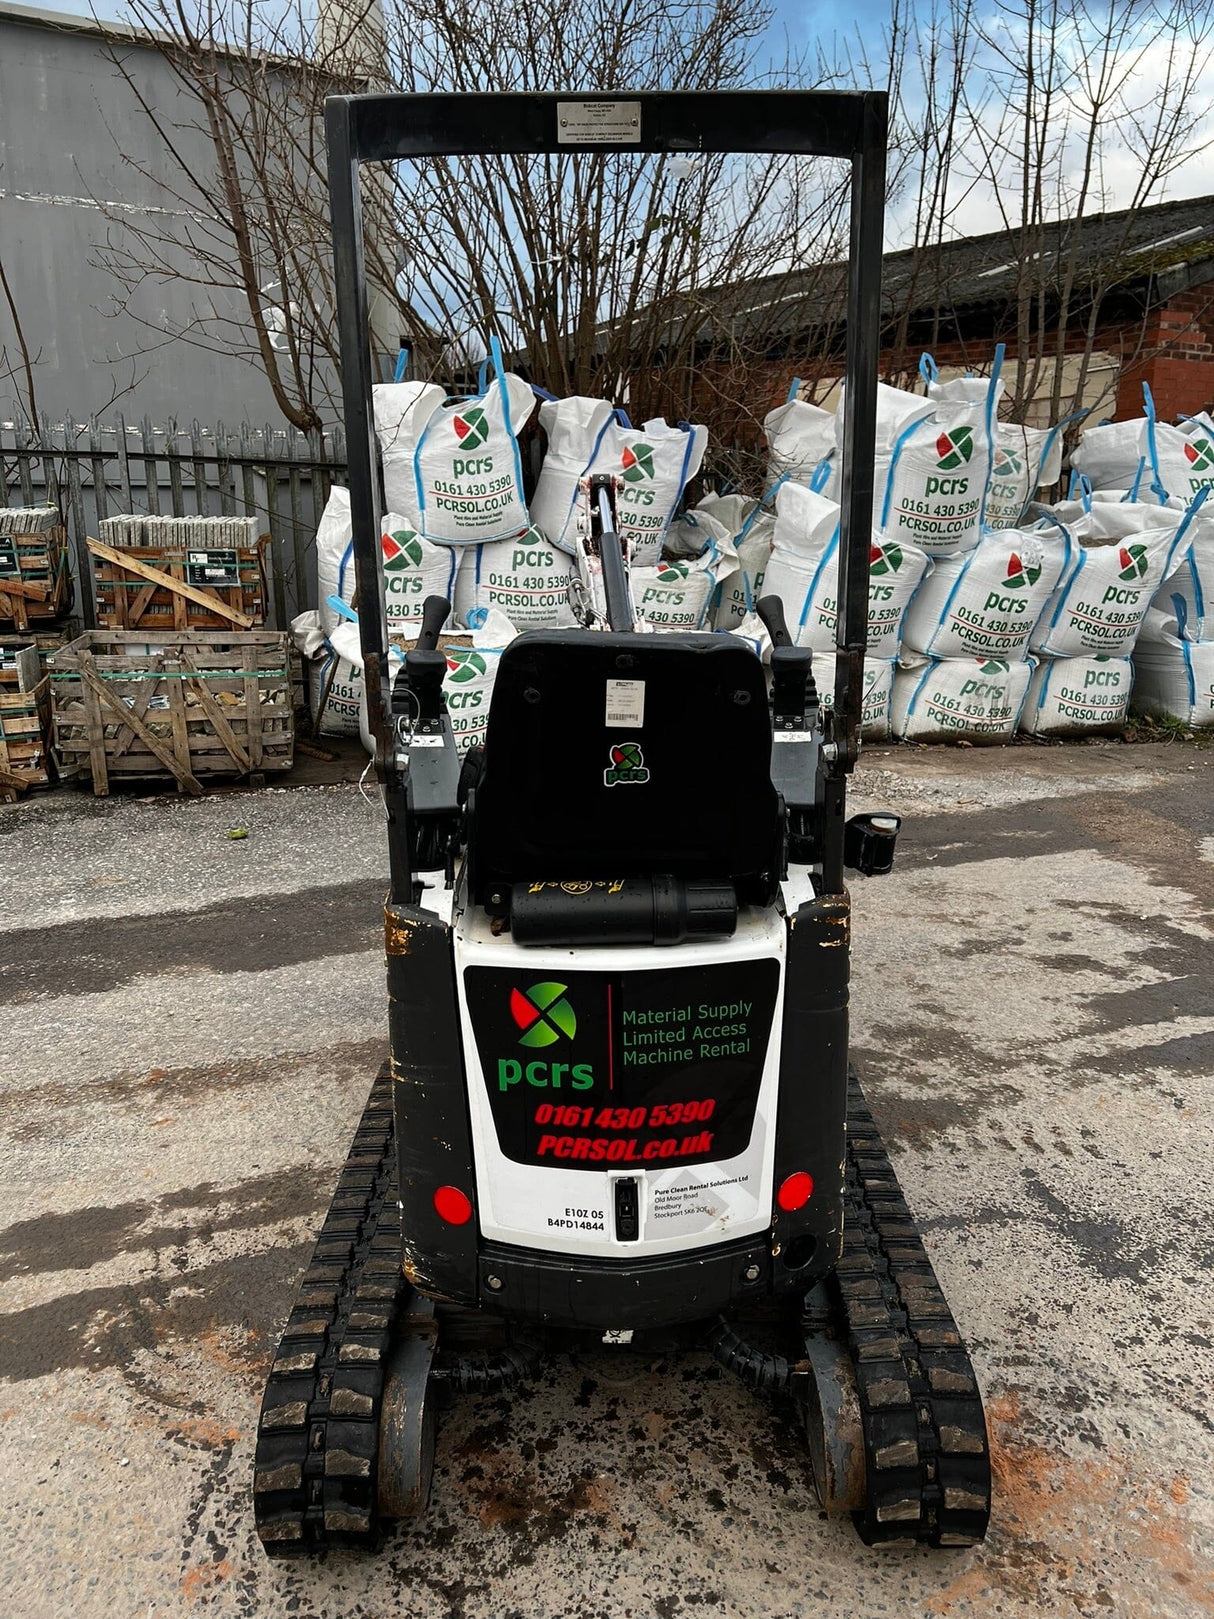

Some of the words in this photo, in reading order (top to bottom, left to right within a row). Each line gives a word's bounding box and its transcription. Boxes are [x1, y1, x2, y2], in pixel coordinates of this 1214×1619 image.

[453, 456, 494, 479] pcrs
[434, 480, 463, 496] 0161
[466, 484, 486, 496] 430
[489, 475, 512, 493] 5390
[925, 476, 969, 498] pcrs
[436, 491, 514, 513] PCRSOL.CO.UK
[902, 498, 930, 515] 0161
[934, 505, 954, 517] 430
[958, 498, 980, 515] 5390
[639, 516, 663, 528] 5390
[899, 515, 976, 534] PCRSOL.CO.UK
[512, 548, 554, 571] pcrs
[489, 573, 519, 588] 0161
[522, 576, 544, 589] 430
[548, 575, 569, 588] 5390
[490, 592, 570, 607] PCRSOL.CO.UK
[642, 588, 685, 605] pcrs
[984, 592, 1028, 614] pcrs
[1102, 584, 1140, 605] pcrs
[648, 611, 669, 622] 430
[671, 613, 694, 623] 5390
[878, 607, 901, 620] 5390
[958, 606, 984, 628] 0161
[986, 621, 1007, 632] 430
[1008, 620, 1033, 633] 5390
[1076, 601, 1104, 620] 0161
[1105, 611, 1125, 623] 430
[951, 622, 1025, 648] PCRSOL.CO.UK
[1069, 616, 1137, 639] PCRSOL.CO.UK
[959, 679, 1006, 699] pcrs
[1084, 669, 1120, 688] pcrs
[933, 692, 960, 711] 0161
[964, 706, 984, 717] 430
[986, 706, 1012, 718] 5390
[1061, 687, 1087, 703] 0161
[1090, 694, 1108, 705] 430
[927, 706, 1005, 732] PCRSOL.CO.UK
[1058, 702, 1124, 722] PCRSOL.CO.UK
[608, 770, 646, 783] pcrs
[622, 1006, 692, 1025] Material
[698, 1000, 753, 1020] Supply
[623, 1027, 685, 1046] Limited
[692, 1021, 747, 1040] Access
[623, 1047, 694, 1066] Machine
[700, 1038, 750, 1058] Rental
[498, 1058, 594, 1092] pcrs
[534, 1104, 592, 1127] 0161
[594, 1106, 646, 1129] 430
[648, 1098, 715, 1127] 5390
[537, 1131, 715, 1161] PCRSOL.co.uk
[689, 1183, 708, 1191] Rental
[710, 1178, 737, 1188] Solutions
[548, 1218, 604, 1231] B4PD14844
[592, 1210, 604, 1219] 05
[654, 1210, 683, 1219] Stockport
